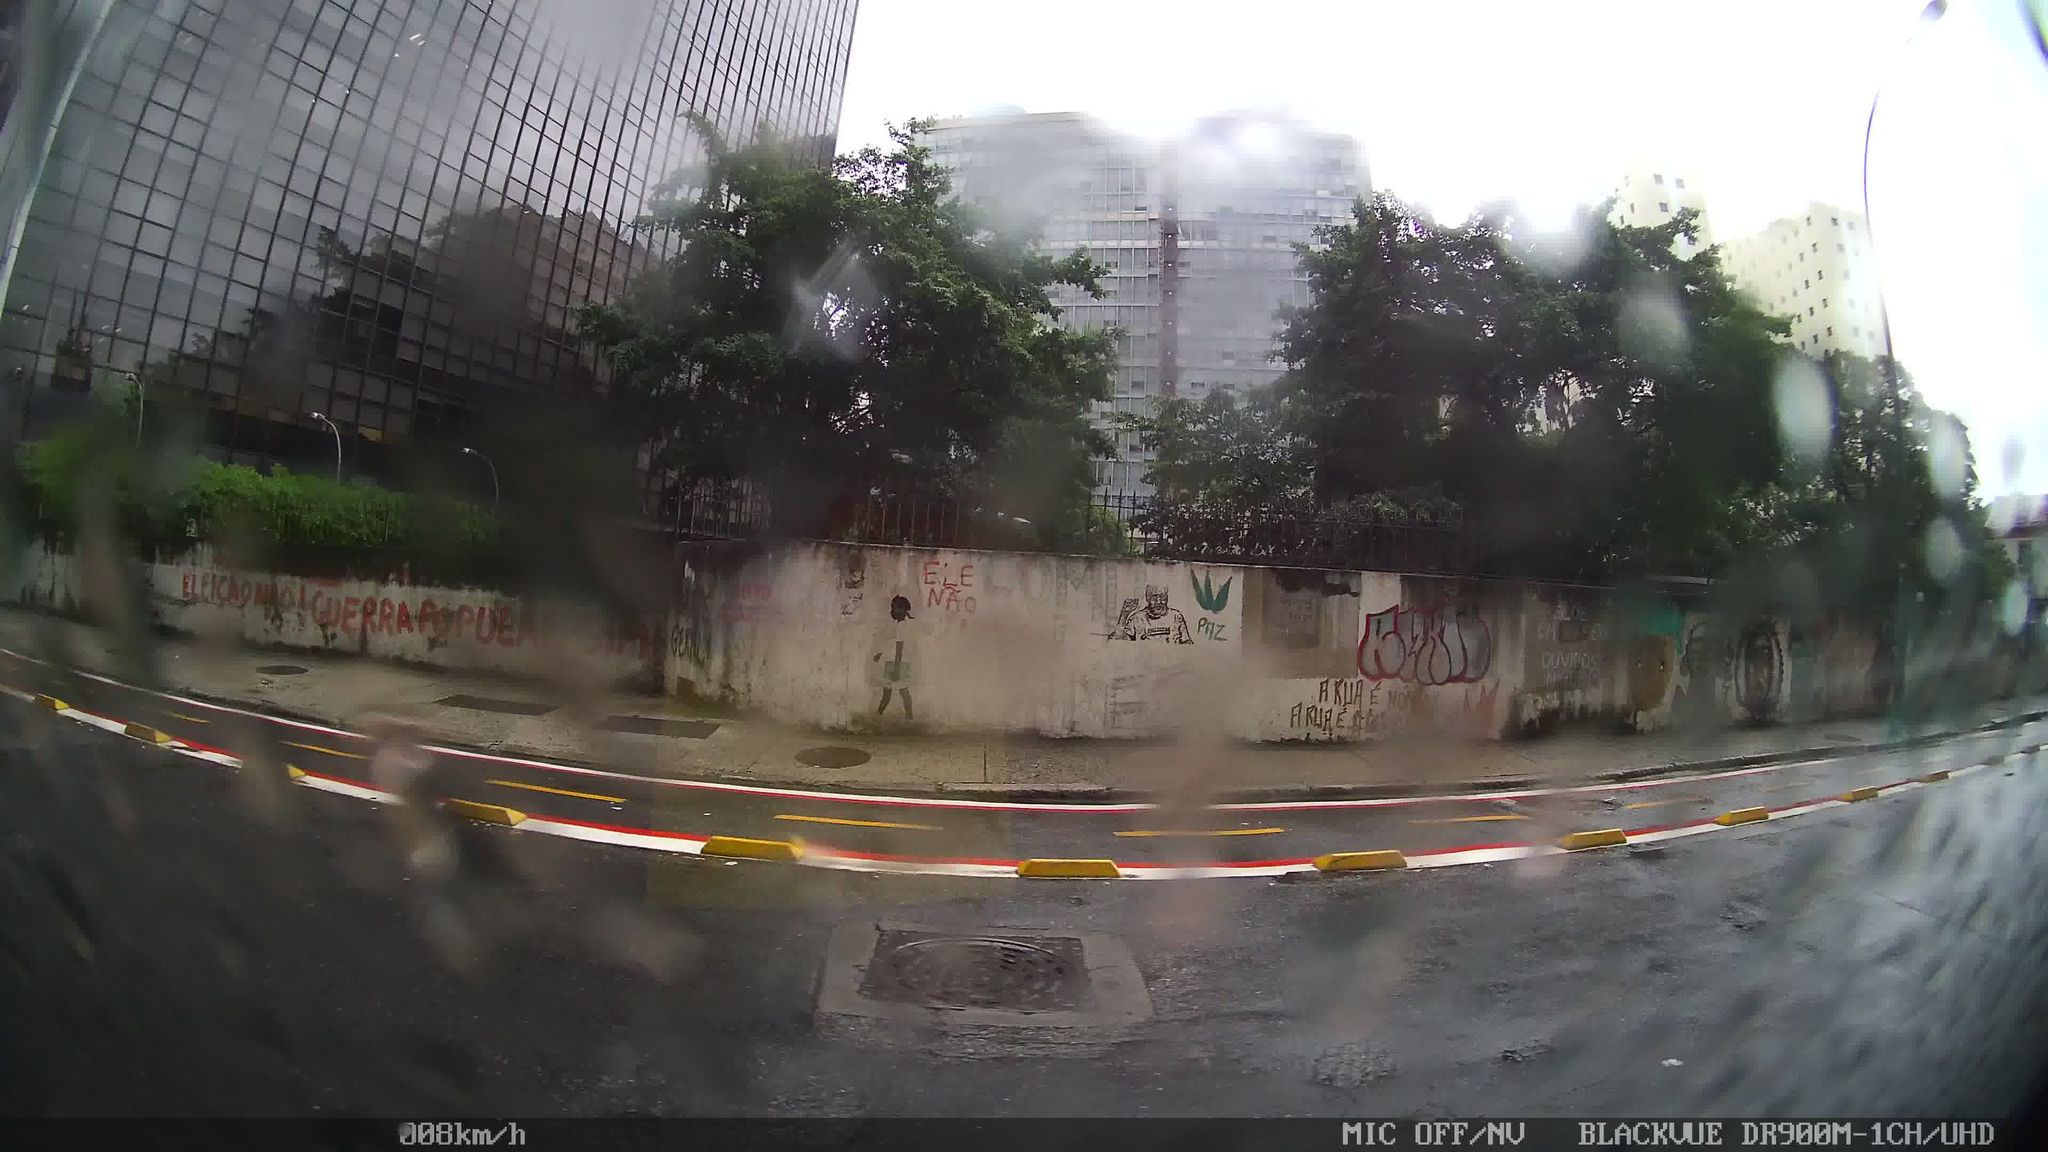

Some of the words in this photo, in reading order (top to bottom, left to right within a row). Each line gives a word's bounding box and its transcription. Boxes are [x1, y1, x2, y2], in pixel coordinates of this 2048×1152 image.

[923, 561, 974, 587] ELE
[927, 587, 976, 613] NÃO
[1198, 617, 1227, 641] PAZ
[1318, 678, 1330, 702] A
[1334, 678, 1364, 712] RUA
[1290, 702, 1302, 729] A
[1305, 704, 1333, 735] RUA
